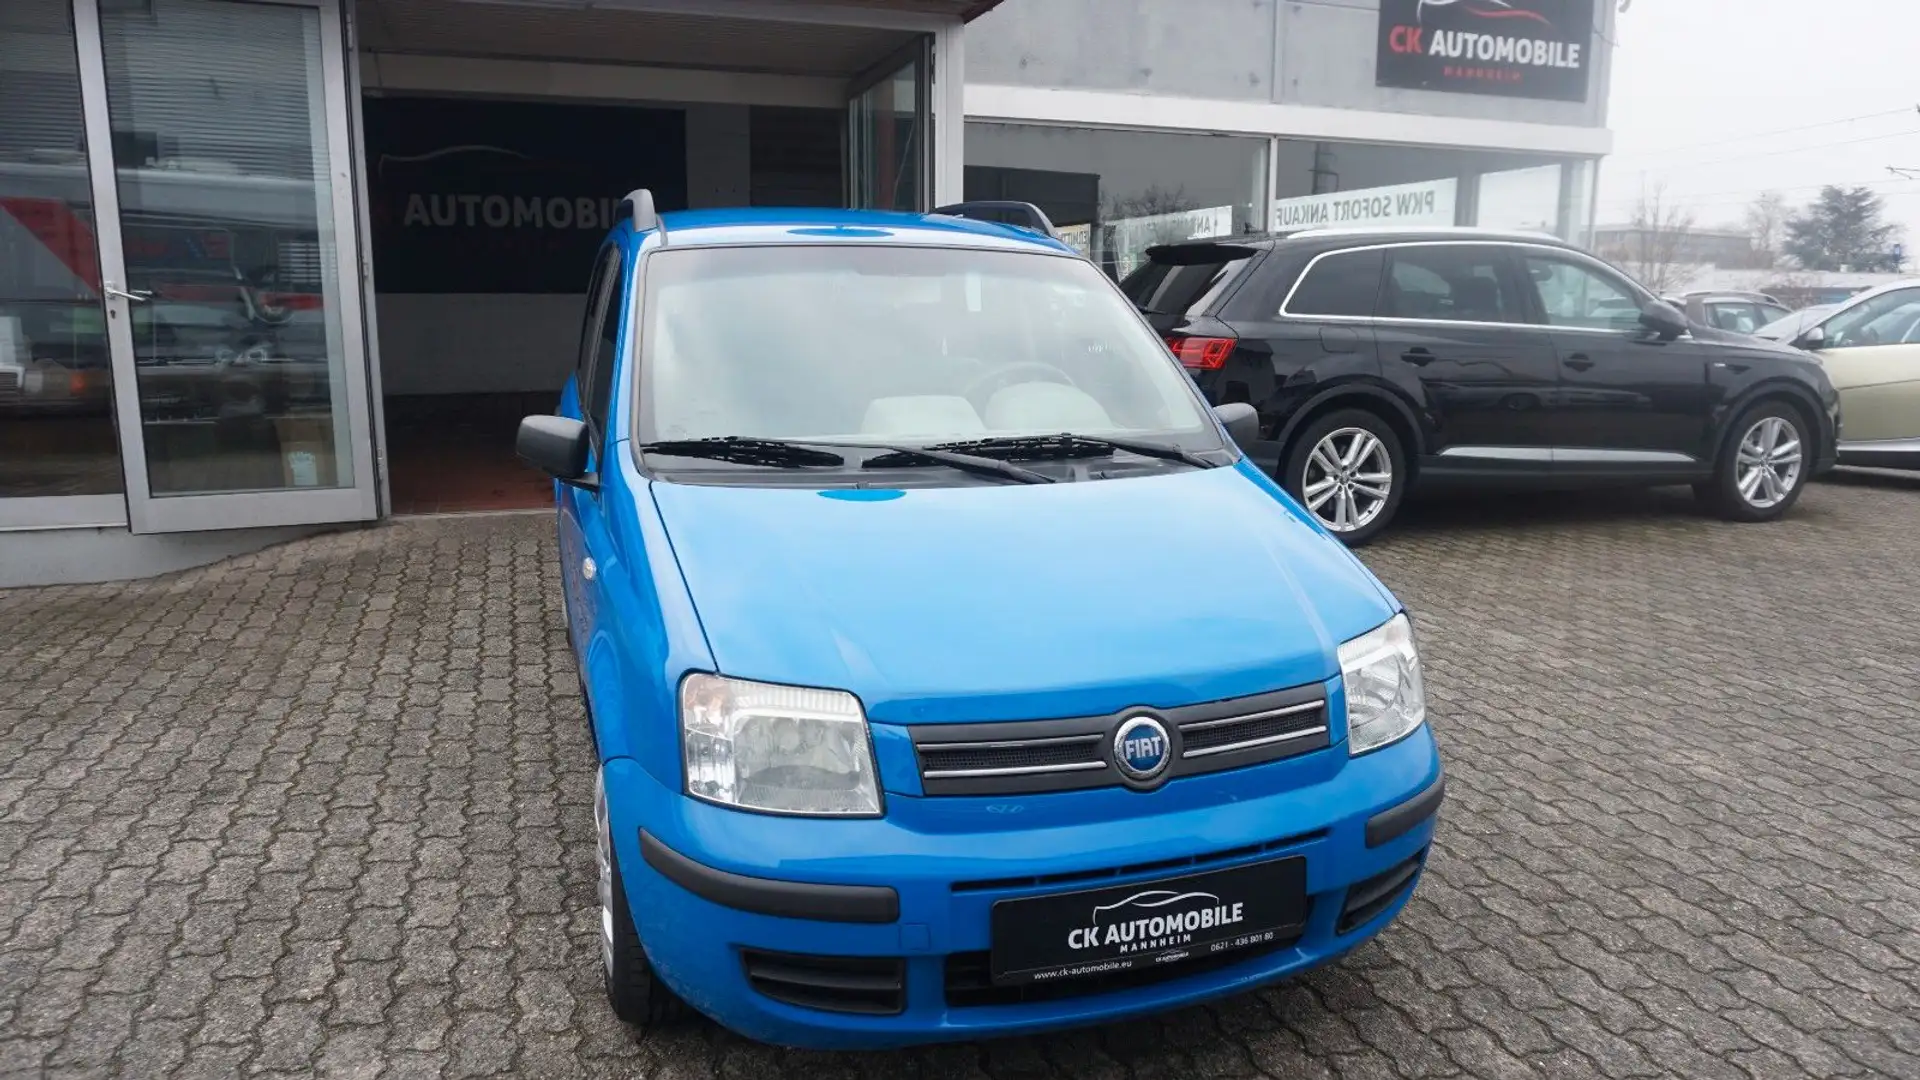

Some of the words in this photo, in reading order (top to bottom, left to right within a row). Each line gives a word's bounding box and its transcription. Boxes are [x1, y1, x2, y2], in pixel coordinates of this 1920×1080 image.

[1388, 25, 1422, 54] CK
[1429, 29, 1580, 68] AUTOMOBILE
[1124, 736, 1162, 760] FIAT
[1068, 926, 1099, 949] CK
[1104, 902, 1244, 945] AUTOMOBILE
[1120, 934, 1192, 954] MANNHEIM
[1210, 941, 1229, 952] 0621
[1033, 961, 1132, 980] www.ck-automobile.eu
